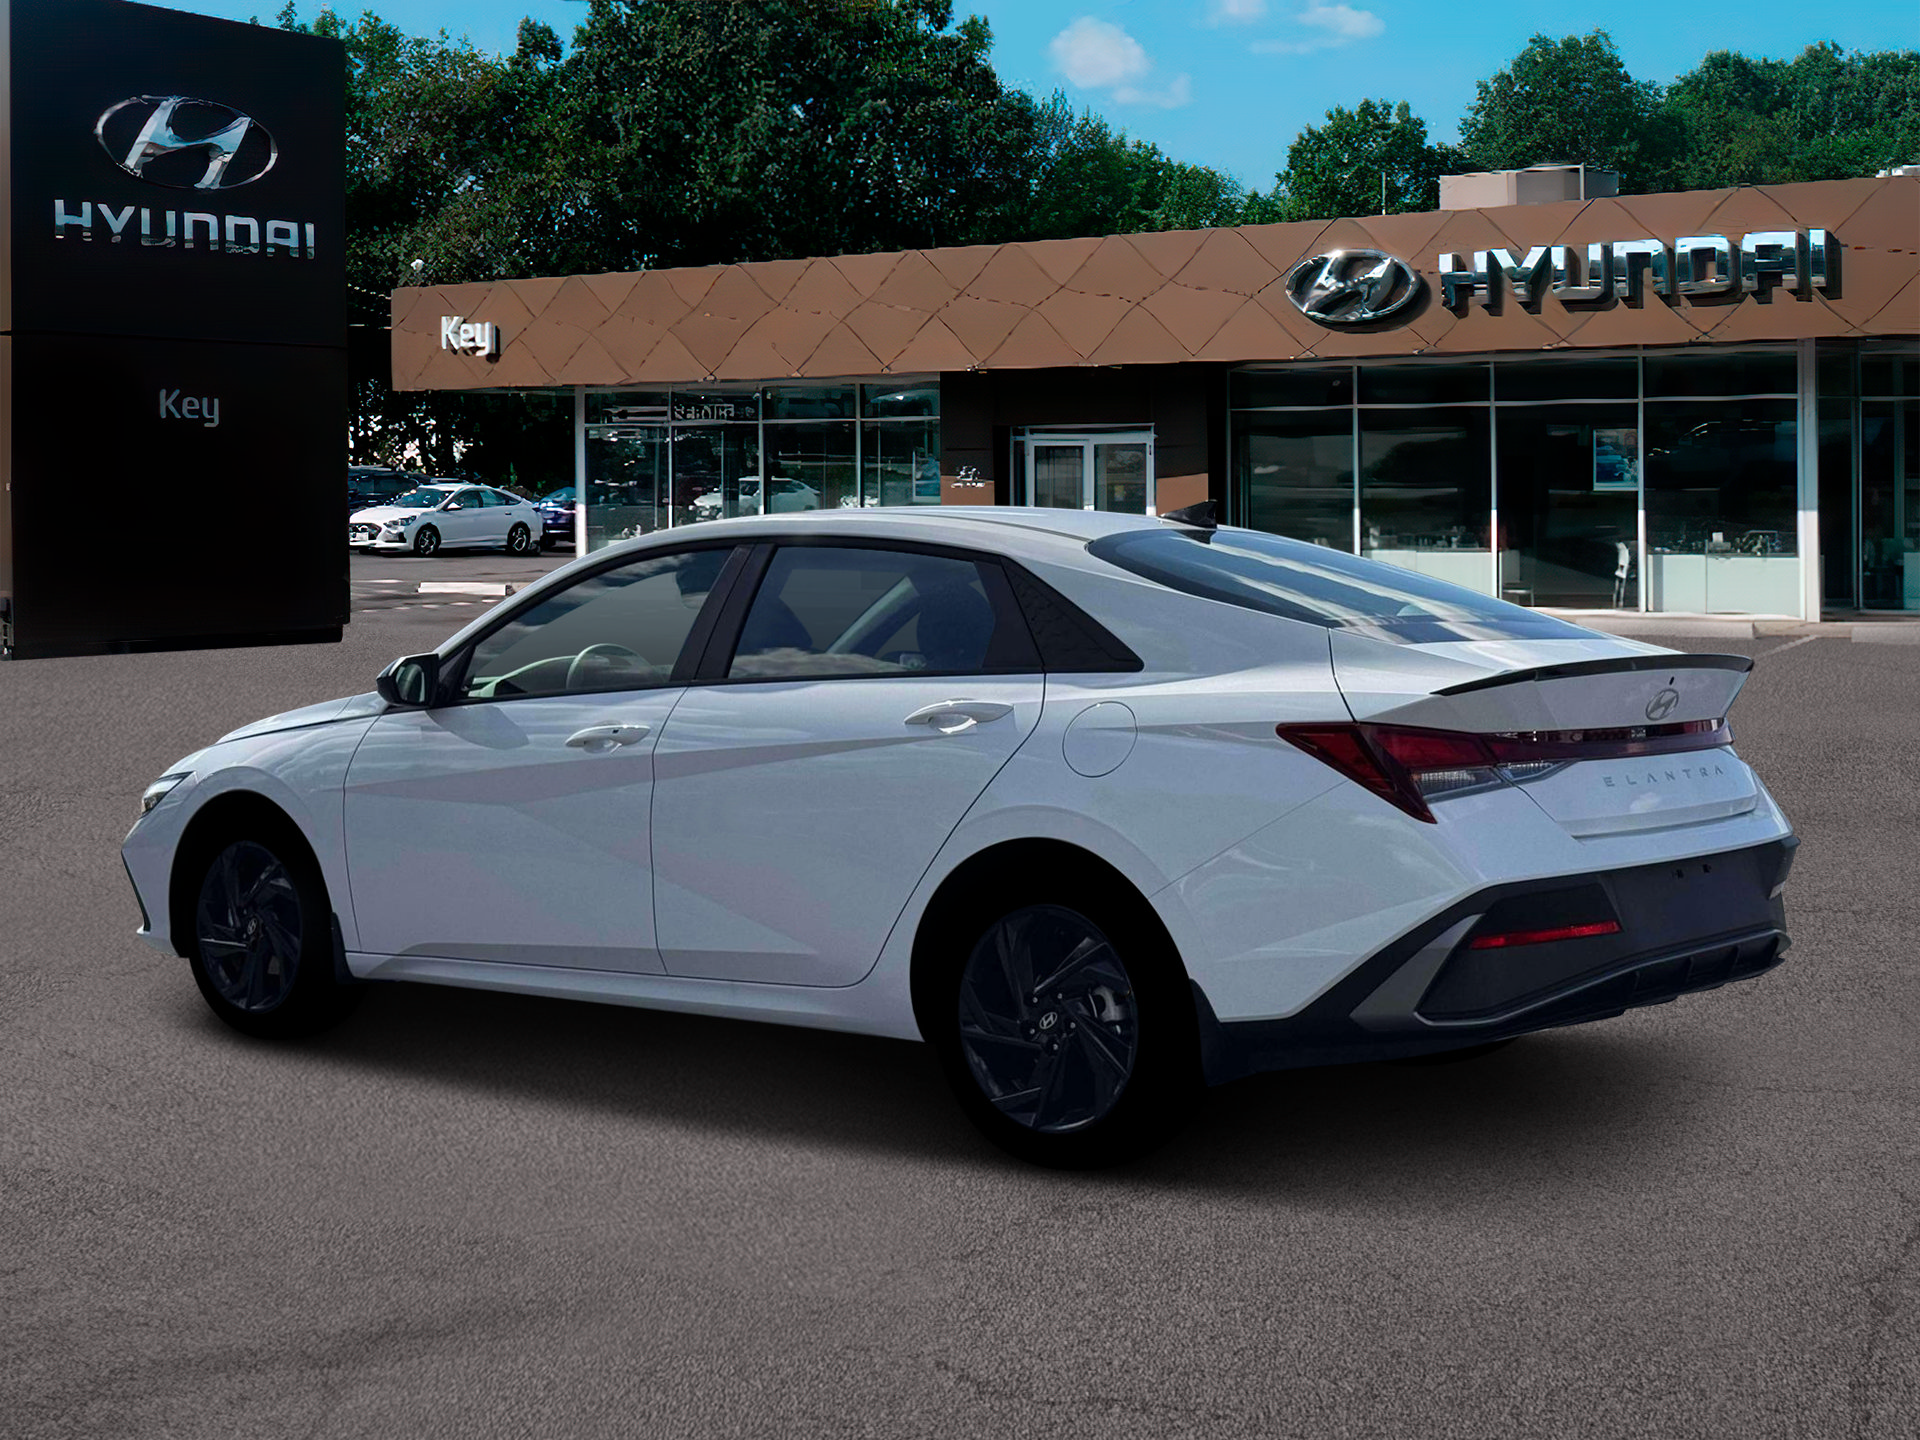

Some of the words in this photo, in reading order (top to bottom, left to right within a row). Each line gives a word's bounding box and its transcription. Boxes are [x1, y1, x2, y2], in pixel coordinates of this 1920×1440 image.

[54, 199, 315, 260] HYUNDAI
[1438, 228, 1840, 312] HYUNDAI
[441, 315, 492, 357] Key
[159, 388, 220, 428] Key
[1603, 764, 1725, 787] ELANTRA
